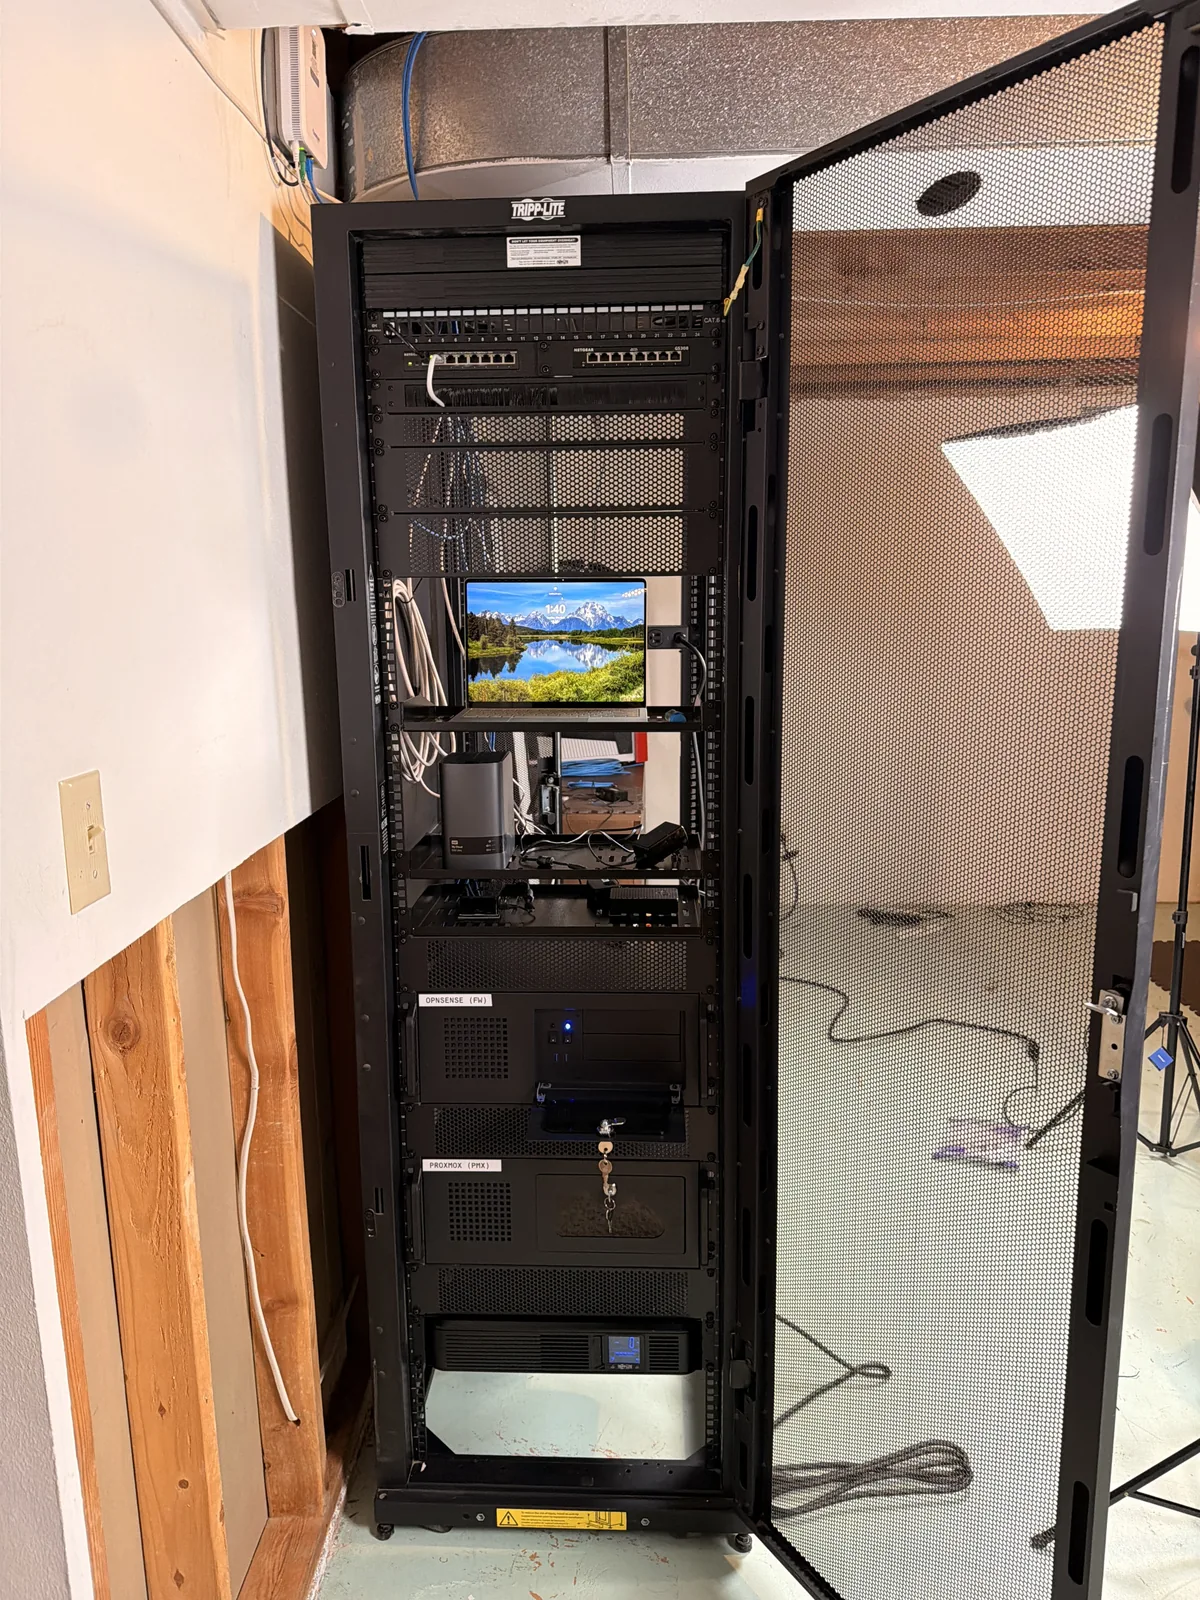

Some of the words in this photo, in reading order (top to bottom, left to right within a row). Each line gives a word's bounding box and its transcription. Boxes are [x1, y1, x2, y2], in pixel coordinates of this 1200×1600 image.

[545, 604, 566, 614] 1:40
[469, 997, 487, 1005] (FW)
[467, 1162, 490, 1170] (PMX)
